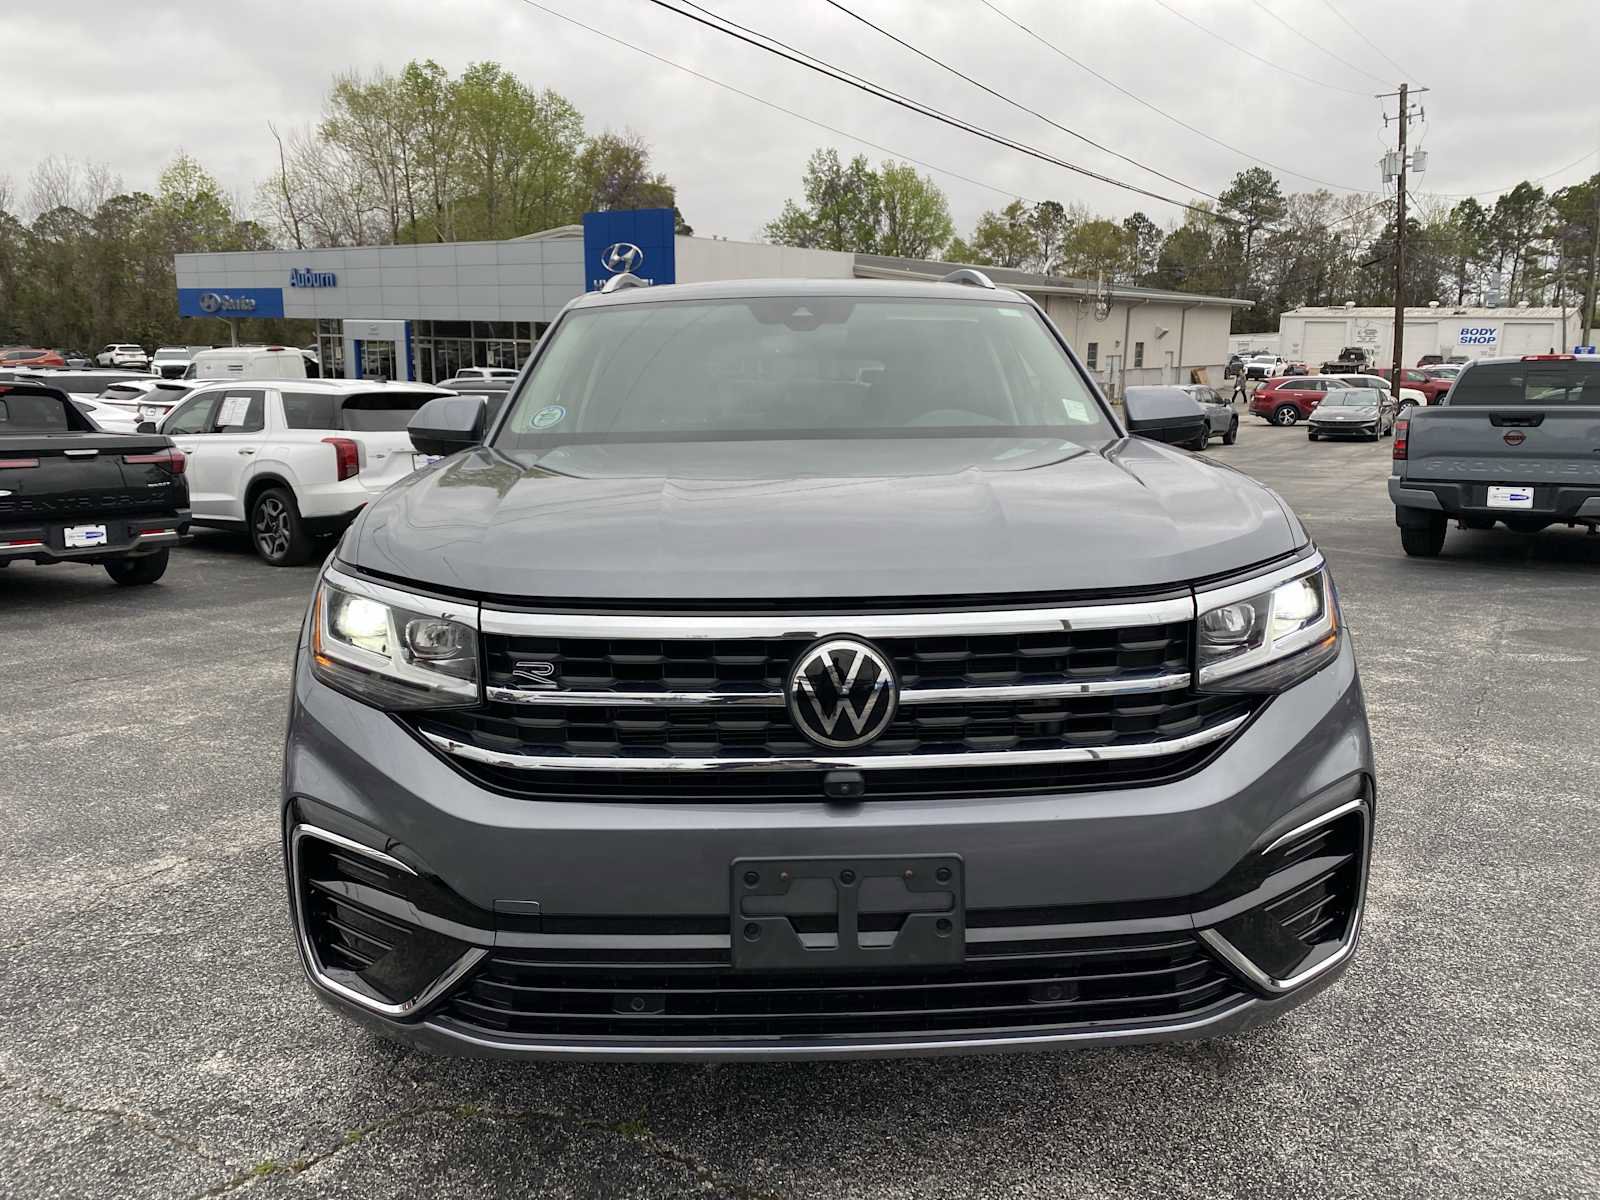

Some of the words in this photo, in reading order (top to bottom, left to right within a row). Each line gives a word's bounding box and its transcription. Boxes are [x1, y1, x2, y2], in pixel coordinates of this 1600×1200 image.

[290, 268, 337, 288] Auburn
[221, 292, 256, 311] Service
[1460, 328, 1497, 336] BODY
[1460, 336, 1496, 344] SHOP
